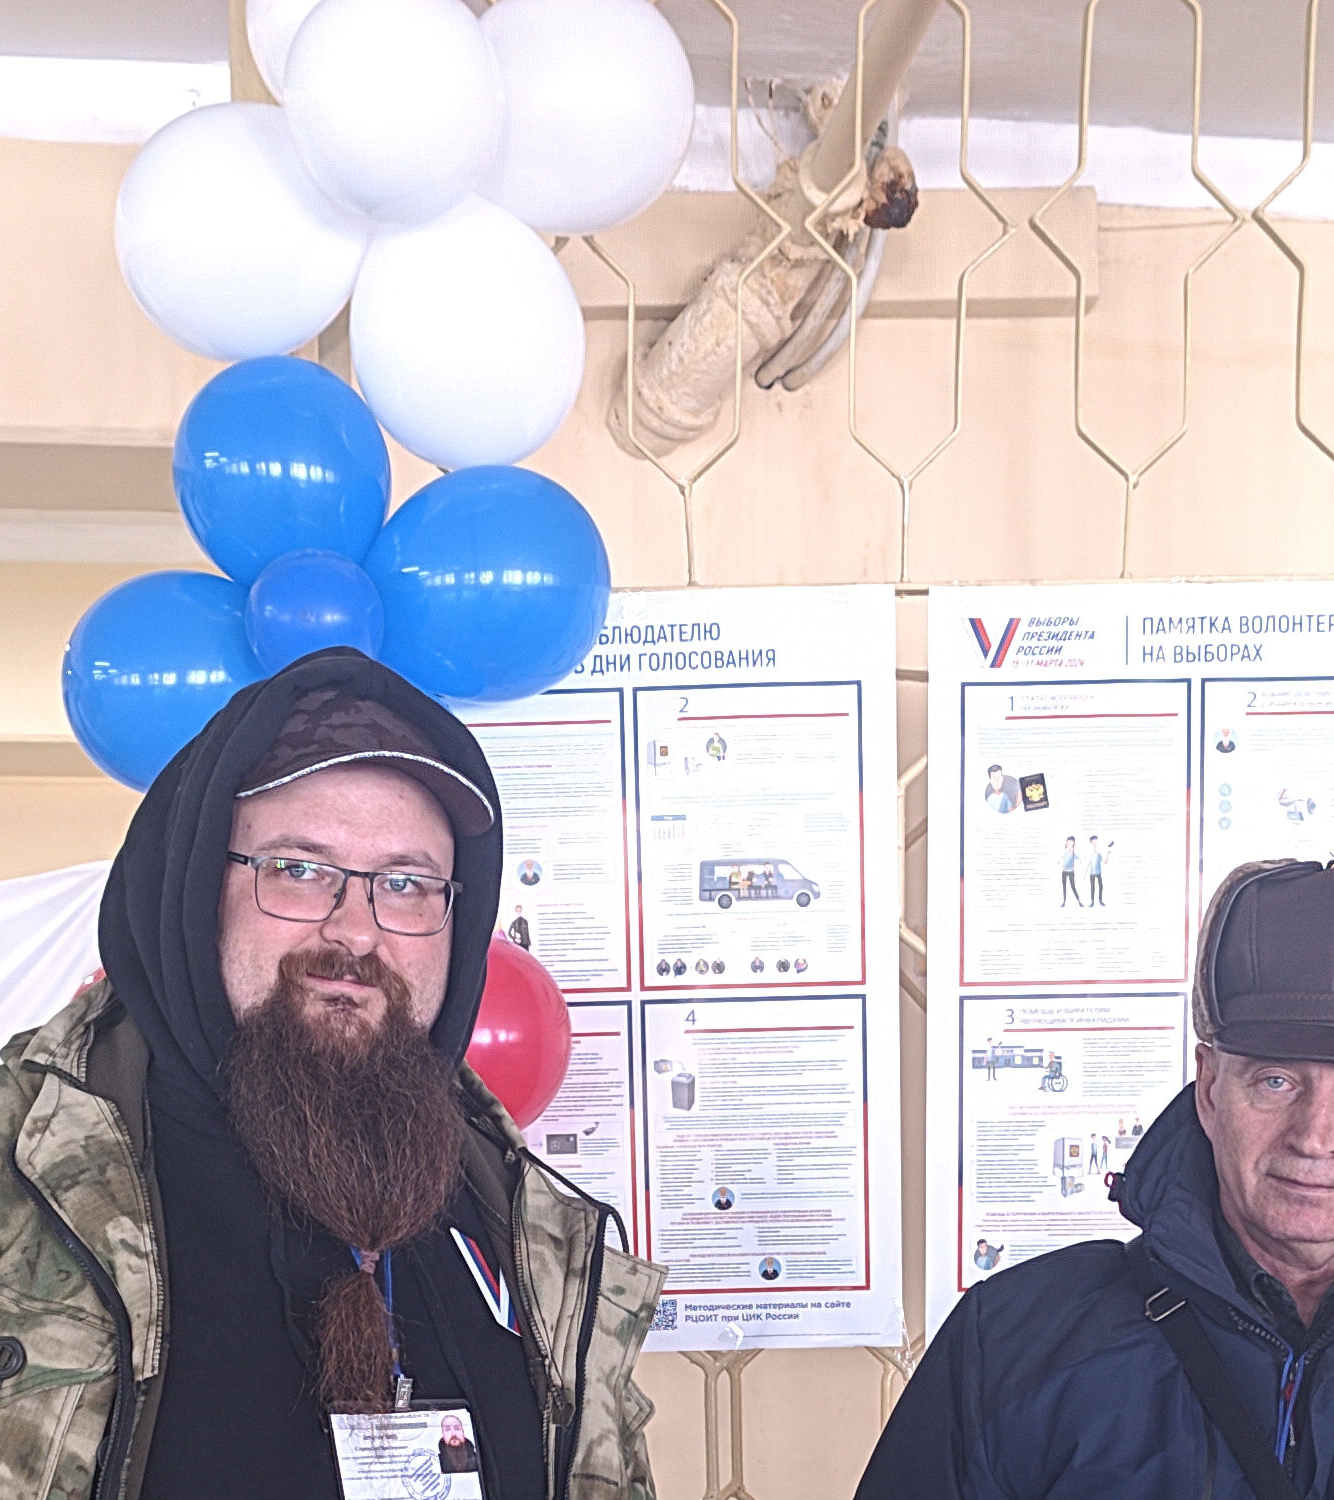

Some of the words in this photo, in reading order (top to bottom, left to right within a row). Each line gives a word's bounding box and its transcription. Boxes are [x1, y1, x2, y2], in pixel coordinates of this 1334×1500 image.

[1027, 616, 1080, 628] ВЫБОРЫ
[1142, 616, 1232, 636] ПАМЯТКА
[596, 622, 721, 646] БЛЮДАТЕЛЮ
[1022, 631, 1095, 643] ПРЕЗИДЕНТА
[1016, 645, 1064, 657] РОССИИ
[1142, 644, 1166, 663] НА
[1174, 643, 1264, 663] ВЫБОРАХ
[590, 654, 631, 676] ДНИ
[639, 648, 776, 672] ГОЛОСОВАНИЯ
[678, 696, 689, 713] 2
[1007, 695, 1014, 712] 1
[1246, 691, 1257, 708] 2
[684, 1009, 697, 1026] 4
[1004, 1008, 1015, 1025] 3
[684, 1303, 753, 1312] Методические
[756, 1302, 808, 1312] материалы
[824, 1300, 851, 1309] сайте
[685, 1314, 719, 1324] РЦОИТ
[721, 1314, 739, 1324] при
[742, 1313, 763, 1323] ЦИК
[765, 1313, 799, 1321] России
